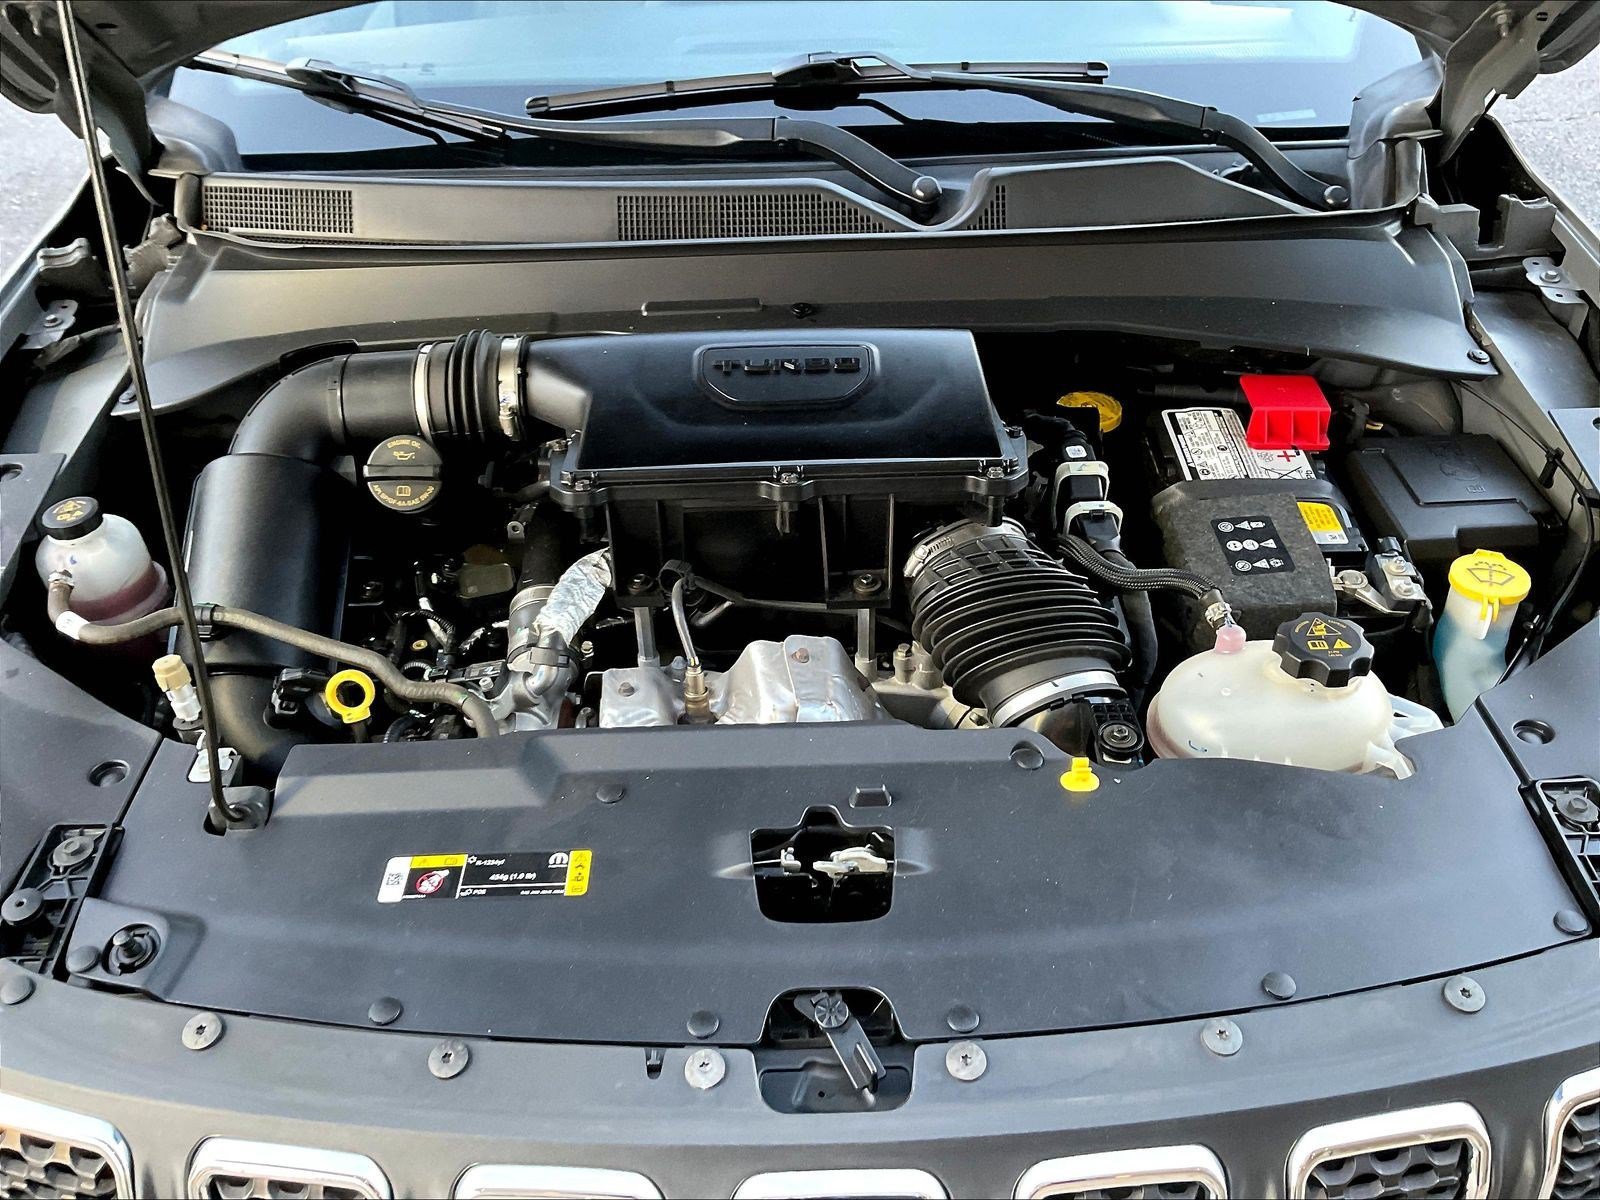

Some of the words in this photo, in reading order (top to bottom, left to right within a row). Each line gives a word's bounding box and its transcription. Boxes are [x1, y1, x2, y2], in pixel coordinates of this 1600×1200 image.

[712, 357, 861, 375] TURBO
[387, 439, 411, 448] ENGINE
[411, 440, 420, 448] OIL
